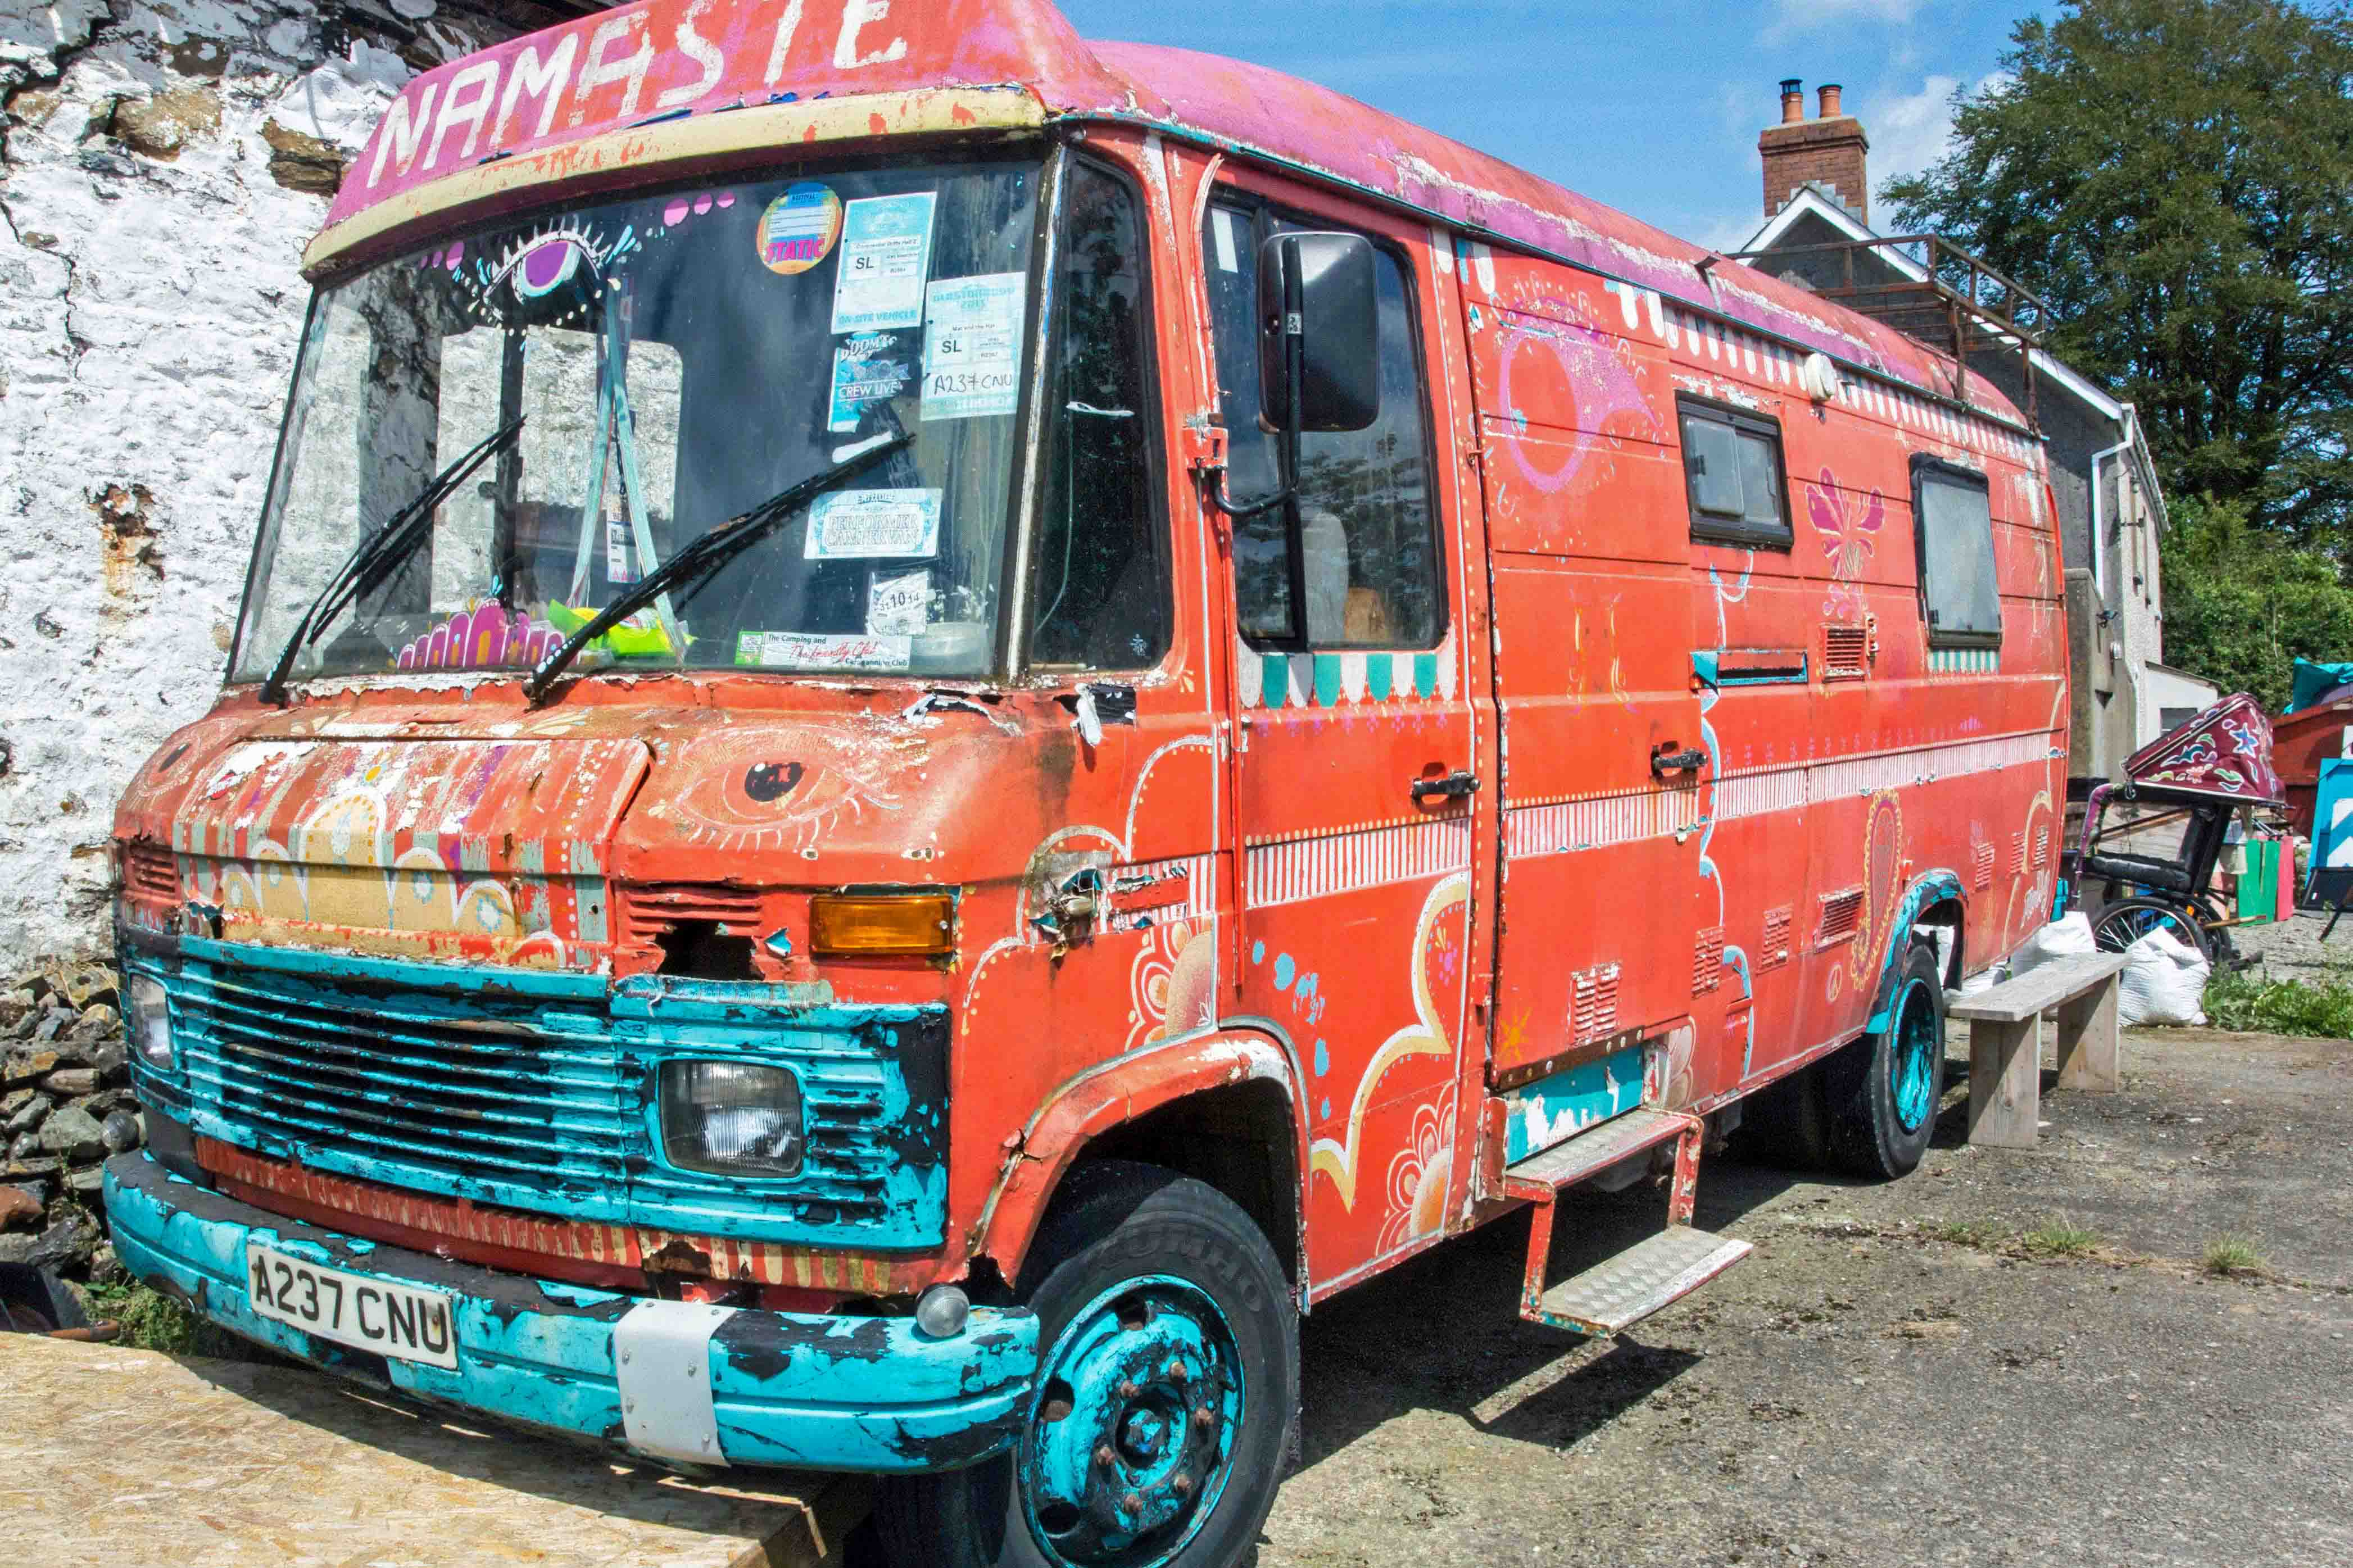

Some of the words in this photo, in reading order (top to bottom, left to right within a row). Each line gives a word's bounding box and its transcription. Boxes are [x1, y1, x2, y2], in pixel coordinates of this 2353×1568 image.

[764, 238, 825, 261] STATIC
[855, 257, 874, 270] SL
[876, 310, 917, 321] VEHICLE
[942, 339, 963, 353] SL
[838, 385, 872, 398] CREW
[890, 592, 906, 608] 10
[908, 592, 920, 604] 14
[782, 635, 811, 644] Camping
[256, 1255, 343, 1330] A237
[356, 1286, 448, 1354] CNU
